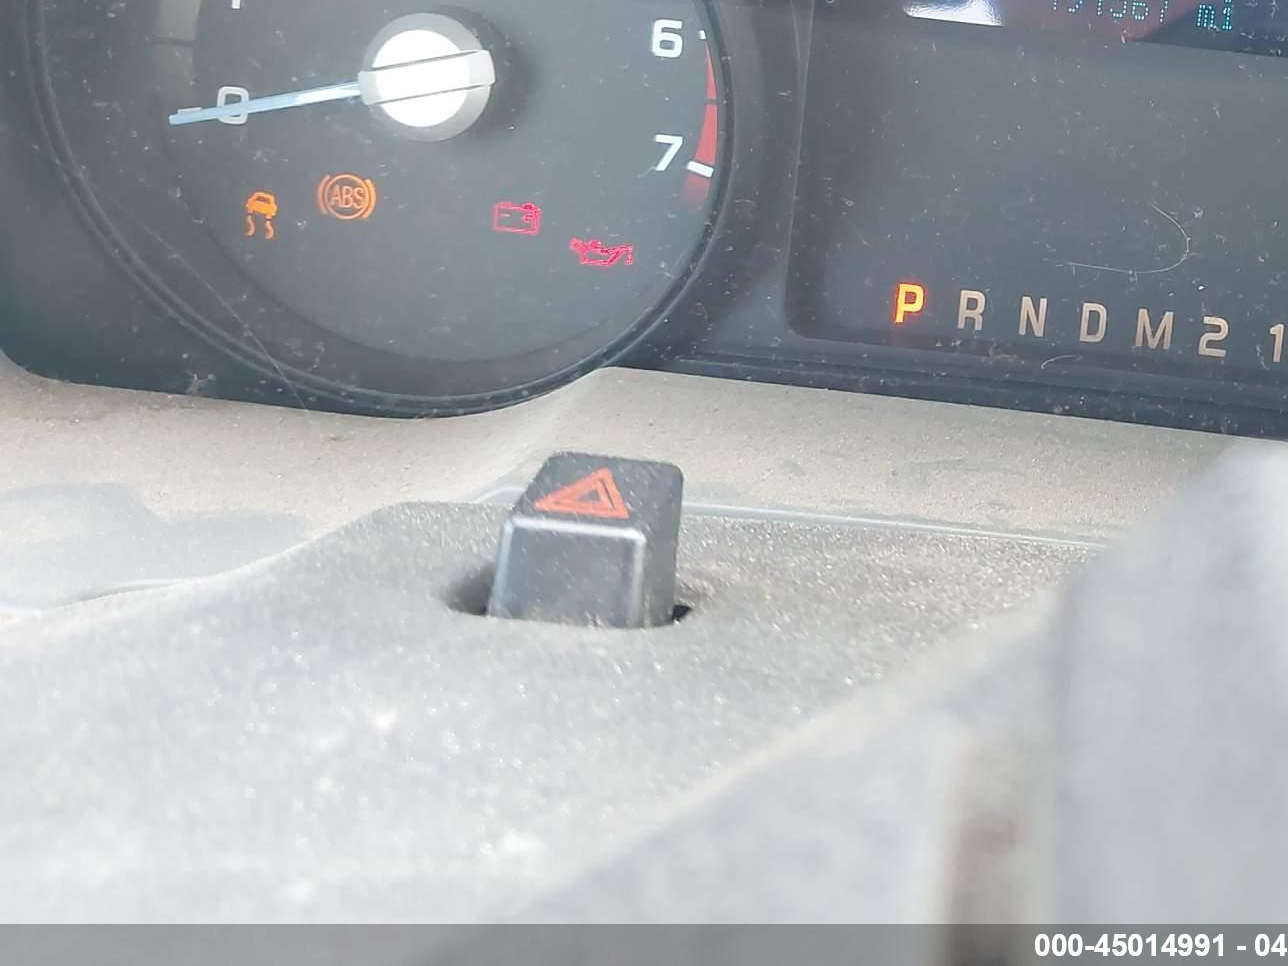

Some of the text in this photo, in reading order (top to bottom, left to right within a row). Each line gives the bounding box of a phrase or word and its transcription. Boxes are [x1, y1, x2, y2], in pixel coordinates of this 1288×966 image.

[651, 19, 684, 58] 6
[217, 86, 249, 125] 0
[655, 135, 683, 171] 7
[330, 184, 365, 210] ABS
[894, 284, 1285, 362] P R N D M 2 1
